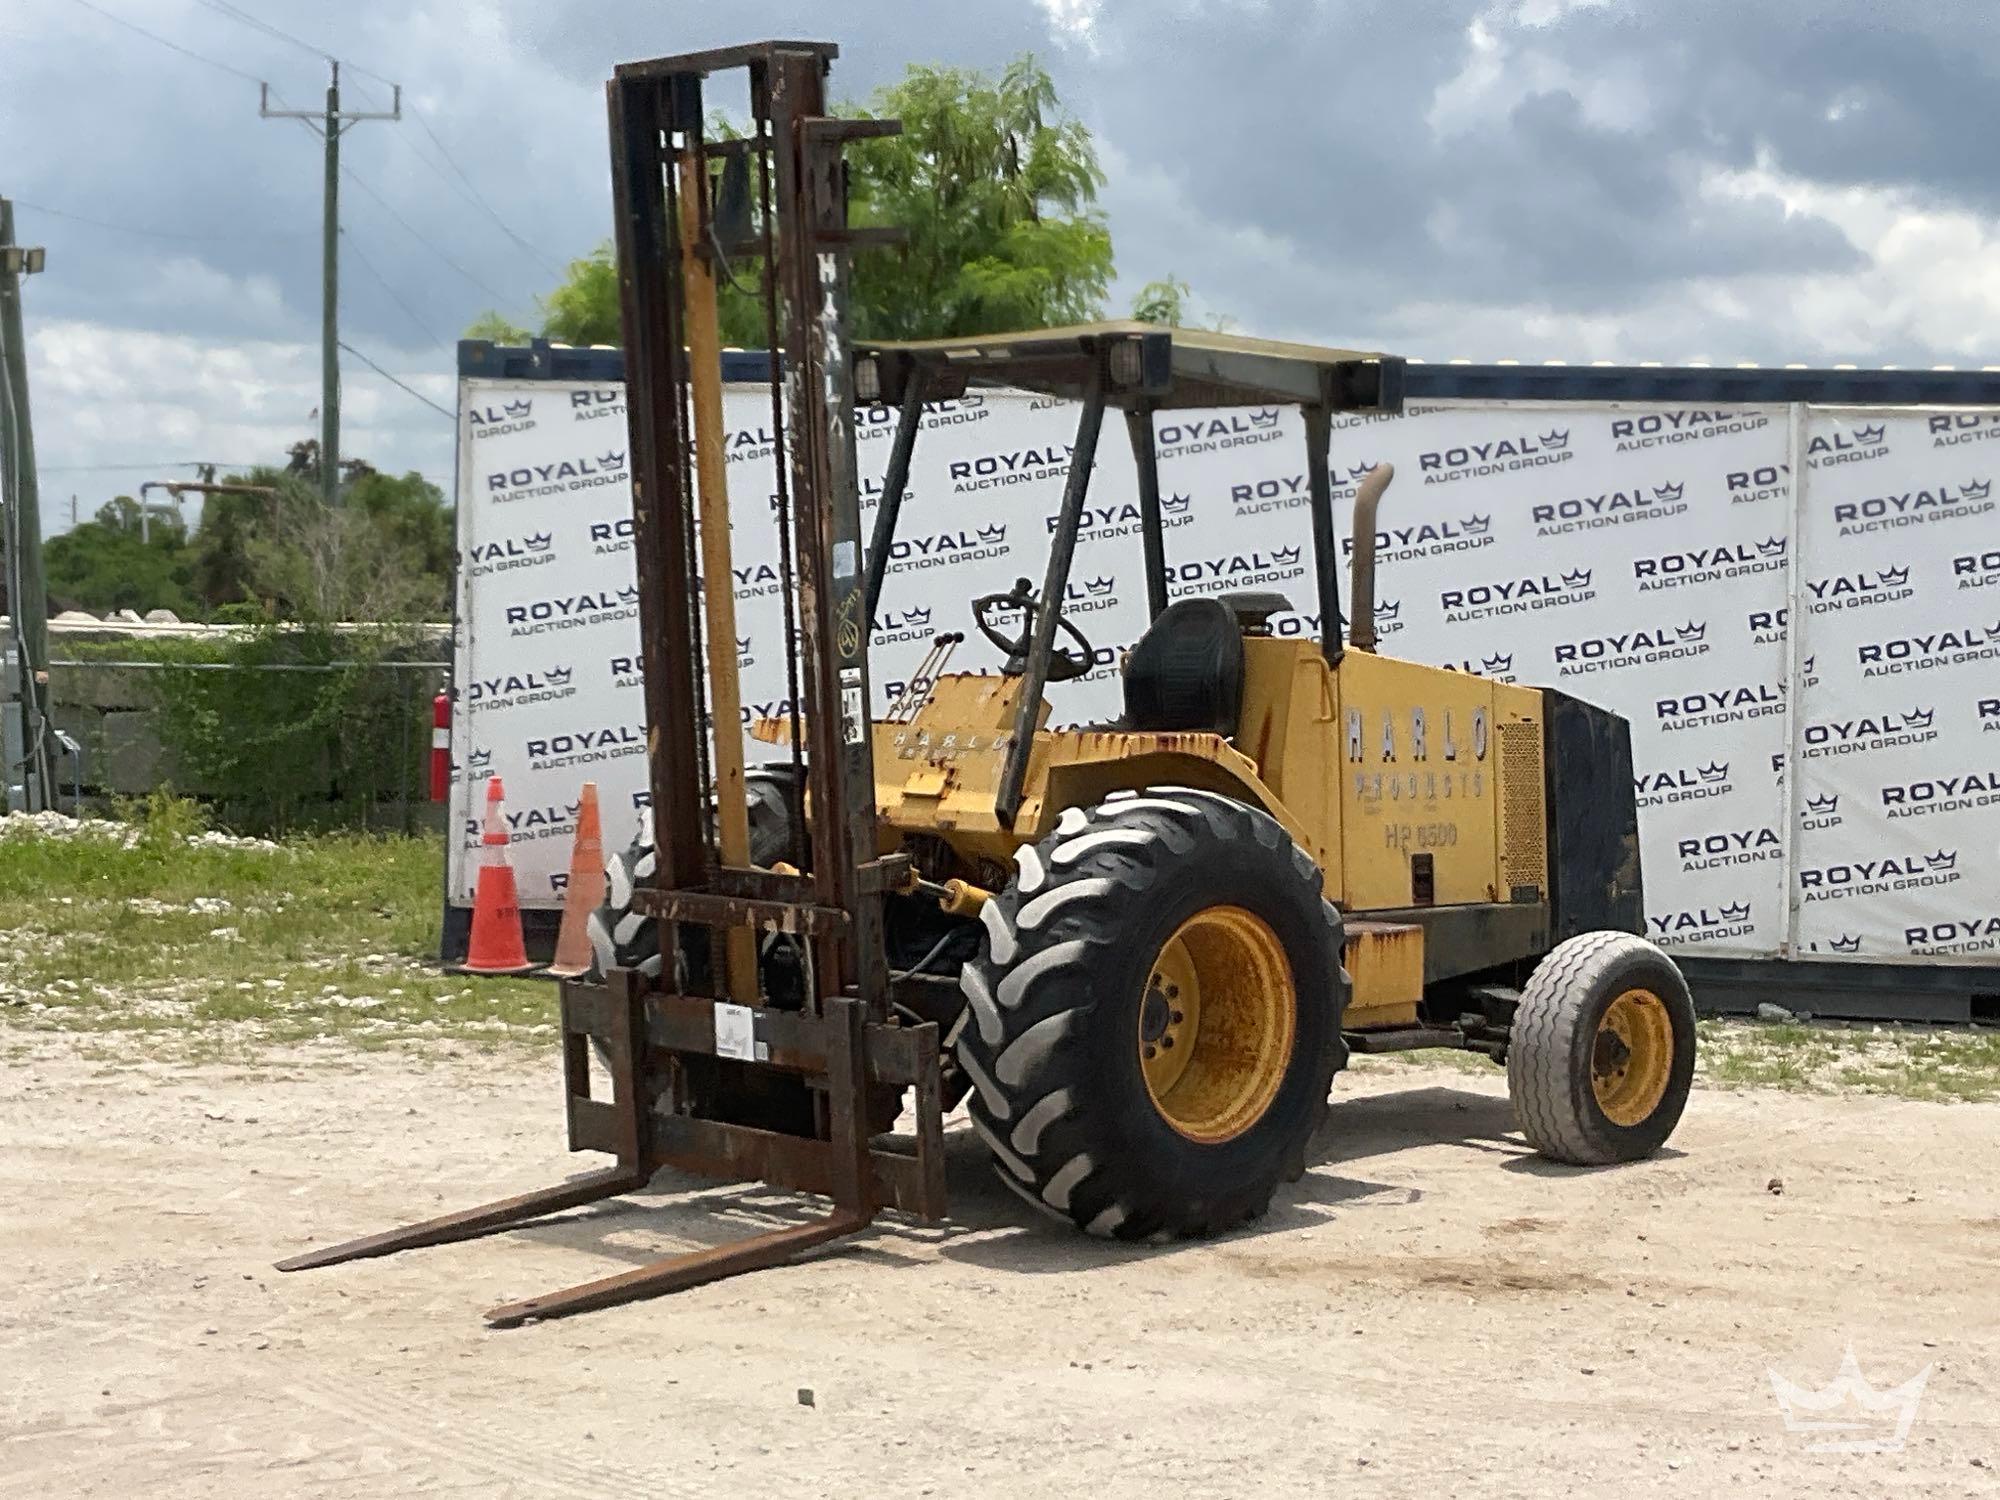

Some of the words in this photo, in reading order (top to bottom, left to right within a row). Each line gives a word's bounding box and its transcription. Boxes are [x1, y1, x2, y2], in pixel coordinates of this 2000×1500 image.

[477, 420, 536, 439] GROUP
[927, 410, 989, 428] GROUP
[1159, 415, 1249, 445] OYAL
[1220, 430, 1283, 448] GROUP
[1616, 430, 1699, 452] AUCTION
[1703, 418, 1769, 438] GROUP
[1933, 427, 2000, 448] AUCTIO
[950, 447, 1064, 480] ROYAL
[1419, 437, 1538, 471] ROYAL
[1424, 462, 1505, 485] AUCTION
[1508, 451, 1574, 471] GROUP
[1823, 447, 1889, 468] GROUP
[488, 459, 597, 491] ROYAL
[492, 484, 566, 504] AUCTION
[569, 472, 629, 491] GROUP
[954, 472, 1032, 493] AUCTION
[1036, 464, 1072, 479] GRO
[1231, 469, 1348, 503] ROYL
[1532, 489, 1653, 523] ROYAL
[1834, 487, 1960, 523] ROYAL
[1839, 514, 1924, 537] AUCTION
[1928, 501, 1995, 522] GROUP
[1076, 522, 1129, 543] CTION
[1537, 515, 1620, 538] AUCTION
[1622, 503, 1688, 524] GROUP
[470, 539, 525, 564] YAL
[887, 531, 977, 559] OYAL
[949, 545, 1010, 564] GROUP
[1430, 535, 1495, 555] GROUP
[498, 553, 556, 573] GROUP
[1634, 544, 1755, 579] ROYAL
[1241, 567, 1305, 586] GROUP
[1638, 569, 1722, 592] AUCTION
[1806, 574, 1877, 599] YAL
[1441, 576, 1561, 609] ROYAL
[1445, 602, 1527, 623] AUCTION
[1531, 590, 1596, 611] GROUP
[1847, 588, 1914, 608] GROUP
[506, 592, 617, 624] ROYAL
[511, 615, 587, 637] AUCTION
[590, 607, 639, 625] GROU
[874, 628, 935, 646] GROUP
[1555, 629, 1676, 663] ROYAL
[1858, 630, 1984, 664] ROYAL
[1559, 655, 1641, 677] AUCTION
[1645, 643, 1710, 663] GROUP
[1864, 656, 1948, 678] AUCTION
[469, 673, 543, 699] OYAL
[517, 687, 576, 706] GROUP
[1656, 684, 1778, 718] ROYAL
[1661, 712, 1743, 732] AUCTION
[1747, 703, 1786, 719] GRO
[1805, 715, 1902, 744] OYAL
[527, 726, 638, 758] ROYAL
[1346, 706, 1488, 763] HARLO
[1870, 730, 1938, 750] GROUP
[531, 750, 607, 770] AUCTION
[609, 744, 647, 758] GRO
[1634, 769, 1697, 794] YAL
[1667, 784, 1732, 803] GROUP
[1886, 798, 1972, 819] AUCTION
[538, 824, 576, 837] GRO
[1679, 828, 1779, 859] ROYA
[1683, 850, 1766, 872] AUCTION
[1800, 856, 1924, 889] ROYAL
[1804, 882, 1889, 903] AUCTION
[1892, 872, 1961, 891] GROUP
[1651, 908, 1720, 933] YAL
[1688, 924, 1755, 942] GROUP
